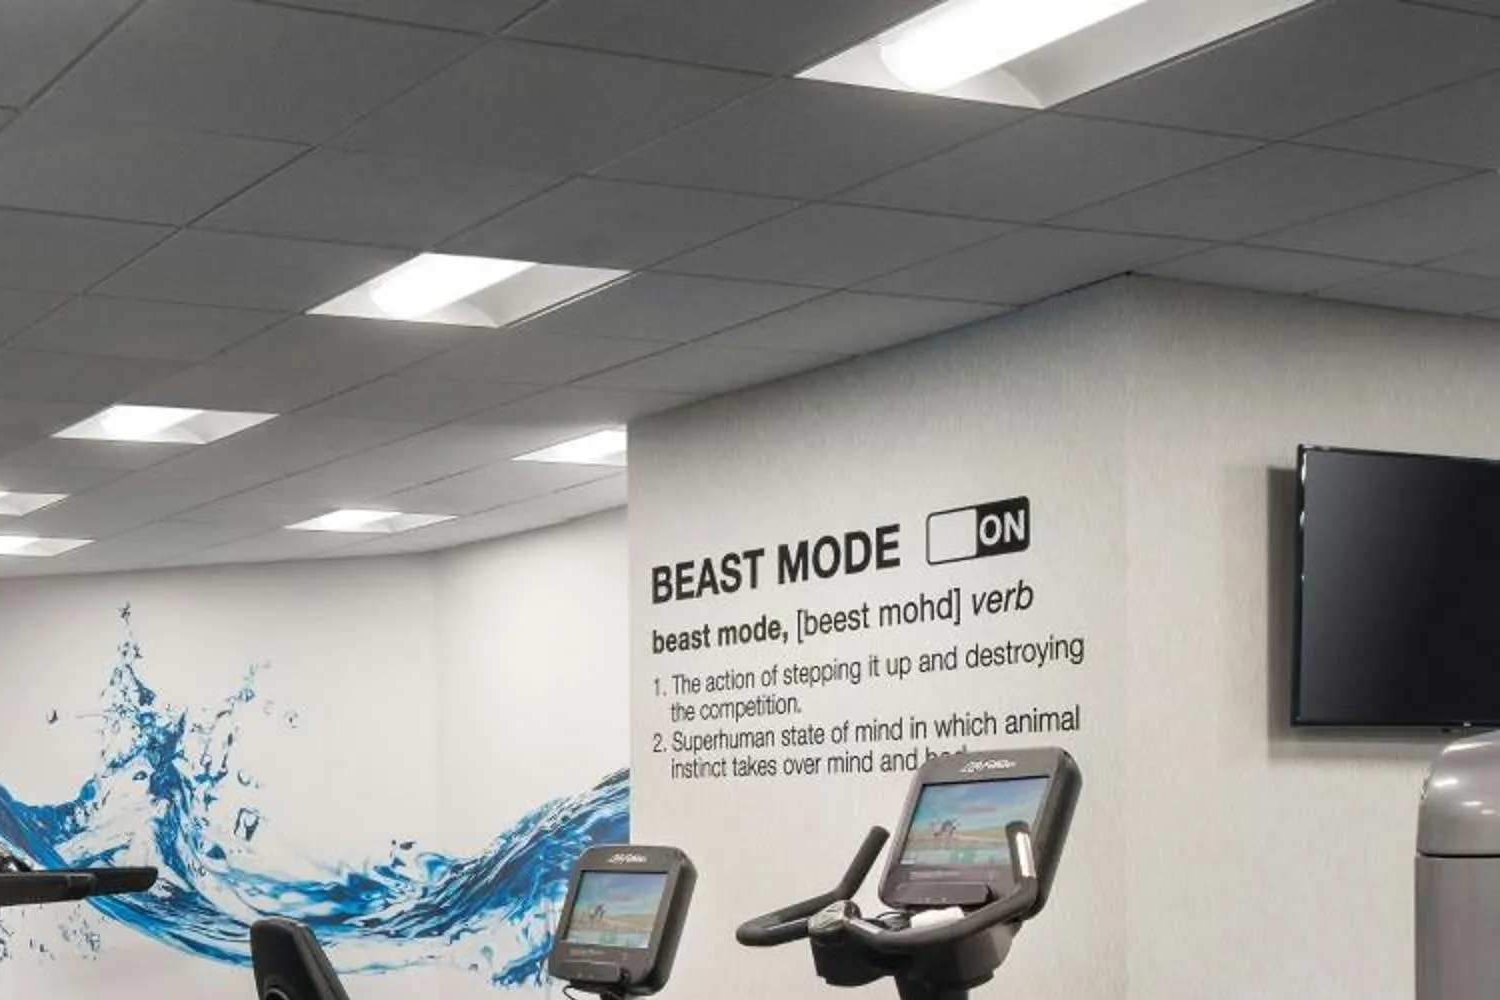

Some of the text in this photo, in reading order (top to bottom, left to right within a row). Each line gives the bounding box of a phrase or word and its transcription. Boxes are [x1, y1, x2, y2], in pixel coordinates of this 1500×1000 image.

[651, 508, 1026, 605] BEAST MODE ON
[652, 578, 1034, 654] beast mode, [beest mohd] verb
[654, 633, 1085, 698] 1. The action of stepping it up and destroying
[652, 703, 1081, 756] 2. Superhuman state of mind in which animal
[670, 694, 802, 723] the competition.
[670, 756, 727, 781] instinct
[731, 754, 778, 778] takes
[783, 755, 822, 776] over
[827, 748, 874, 775] mind
[879, 747, 919, 773] and
